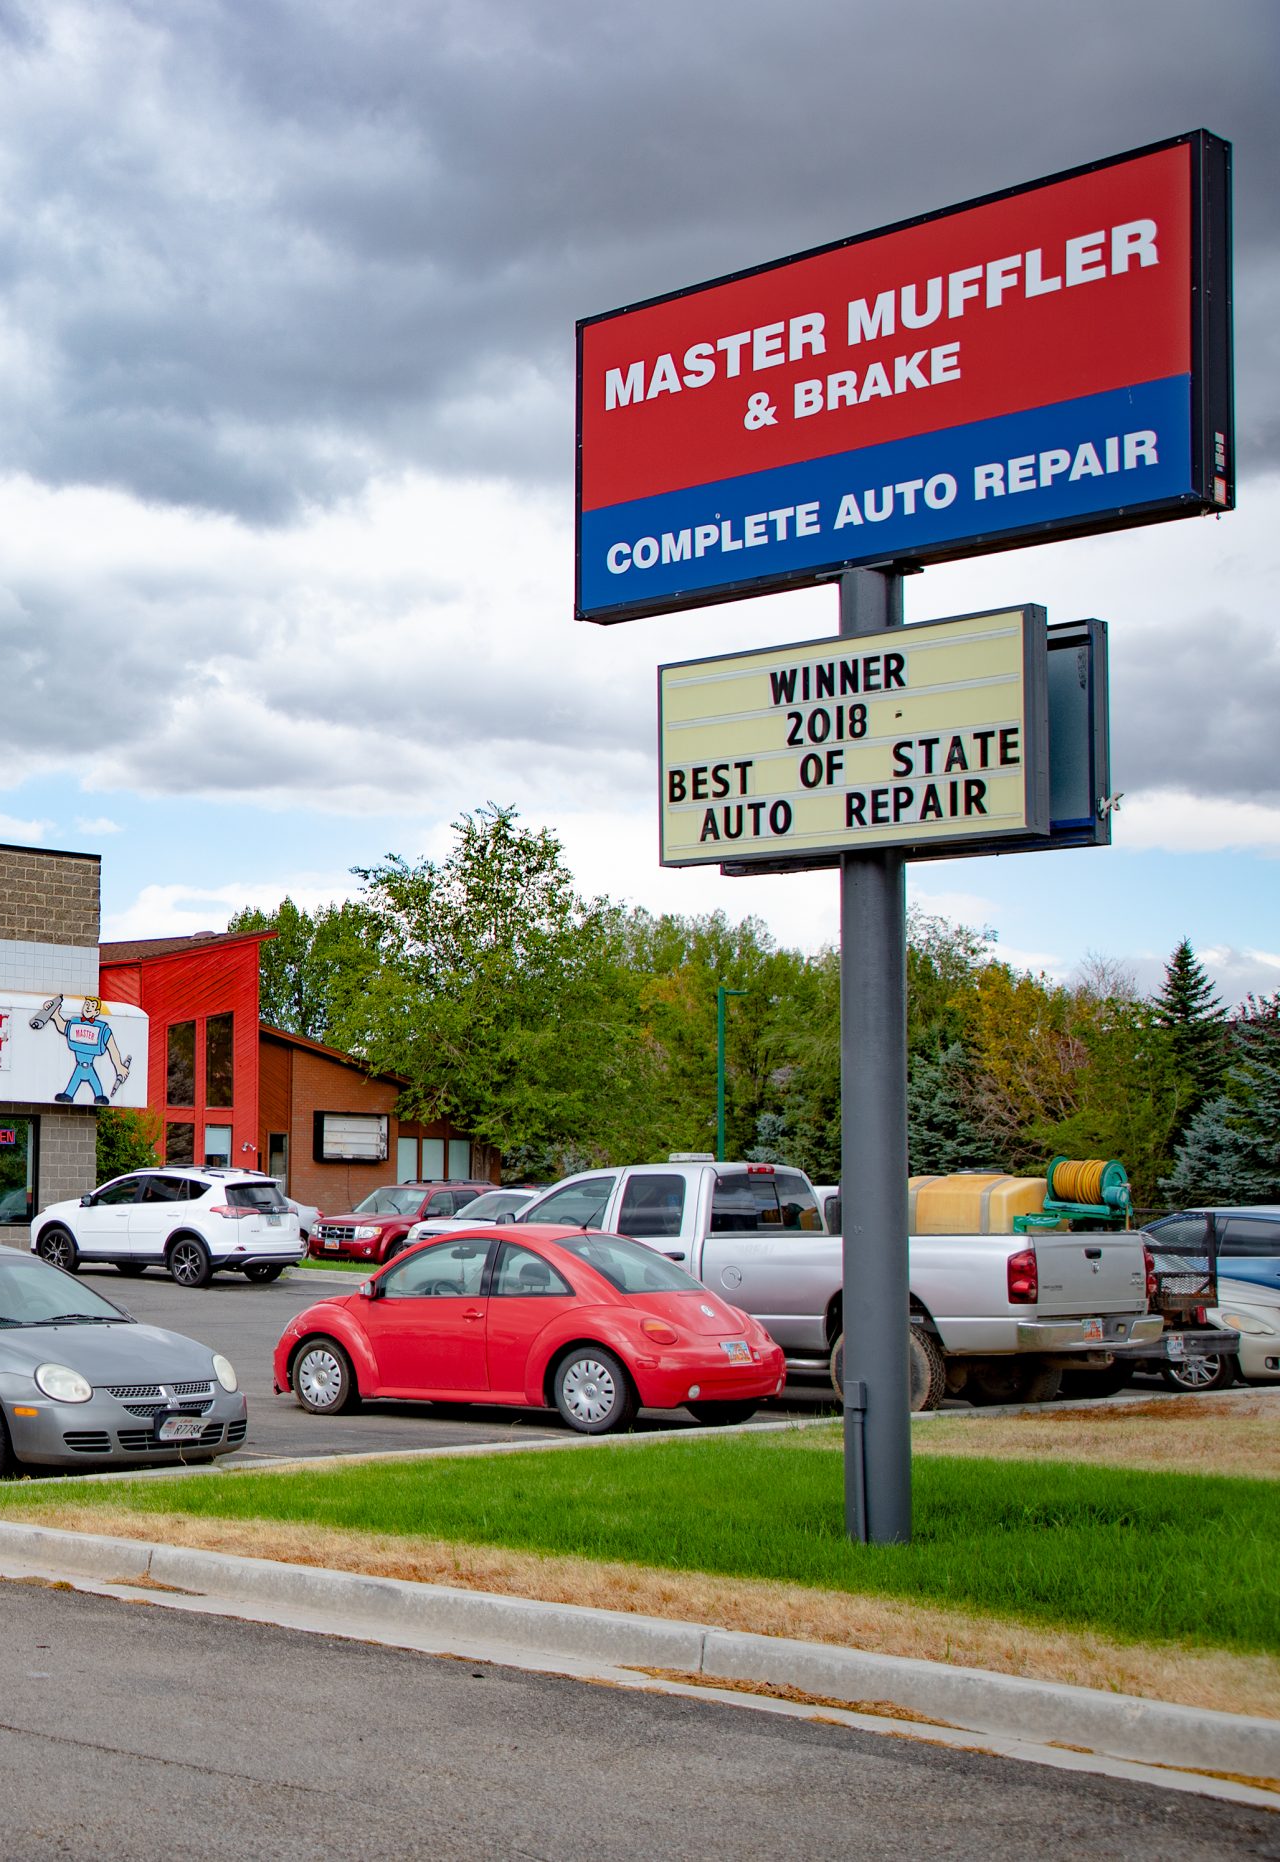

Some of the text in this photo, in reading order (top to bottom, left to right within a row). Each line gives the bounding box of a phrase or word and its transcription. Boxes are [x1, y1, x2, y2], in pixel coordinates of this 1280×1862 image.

[605, 218, 1160, 411] MASTER MUFFLER
[743, 341, 962, 431] & BRAKE
[606, 501, 820, 575] COMPLETE
[833, 472, 957, 530] AUTO
[973, 430, 1159, 500] REPAIR
[769, 652, 907, 706] WINNER
[786, 702, 868, 746] 2018
[668, 727, 1021, 804] BEST OF STATE
[699, 778, 987, 842] AUTO REPAIR
[76, 1030, 98, 1042] MASTER
